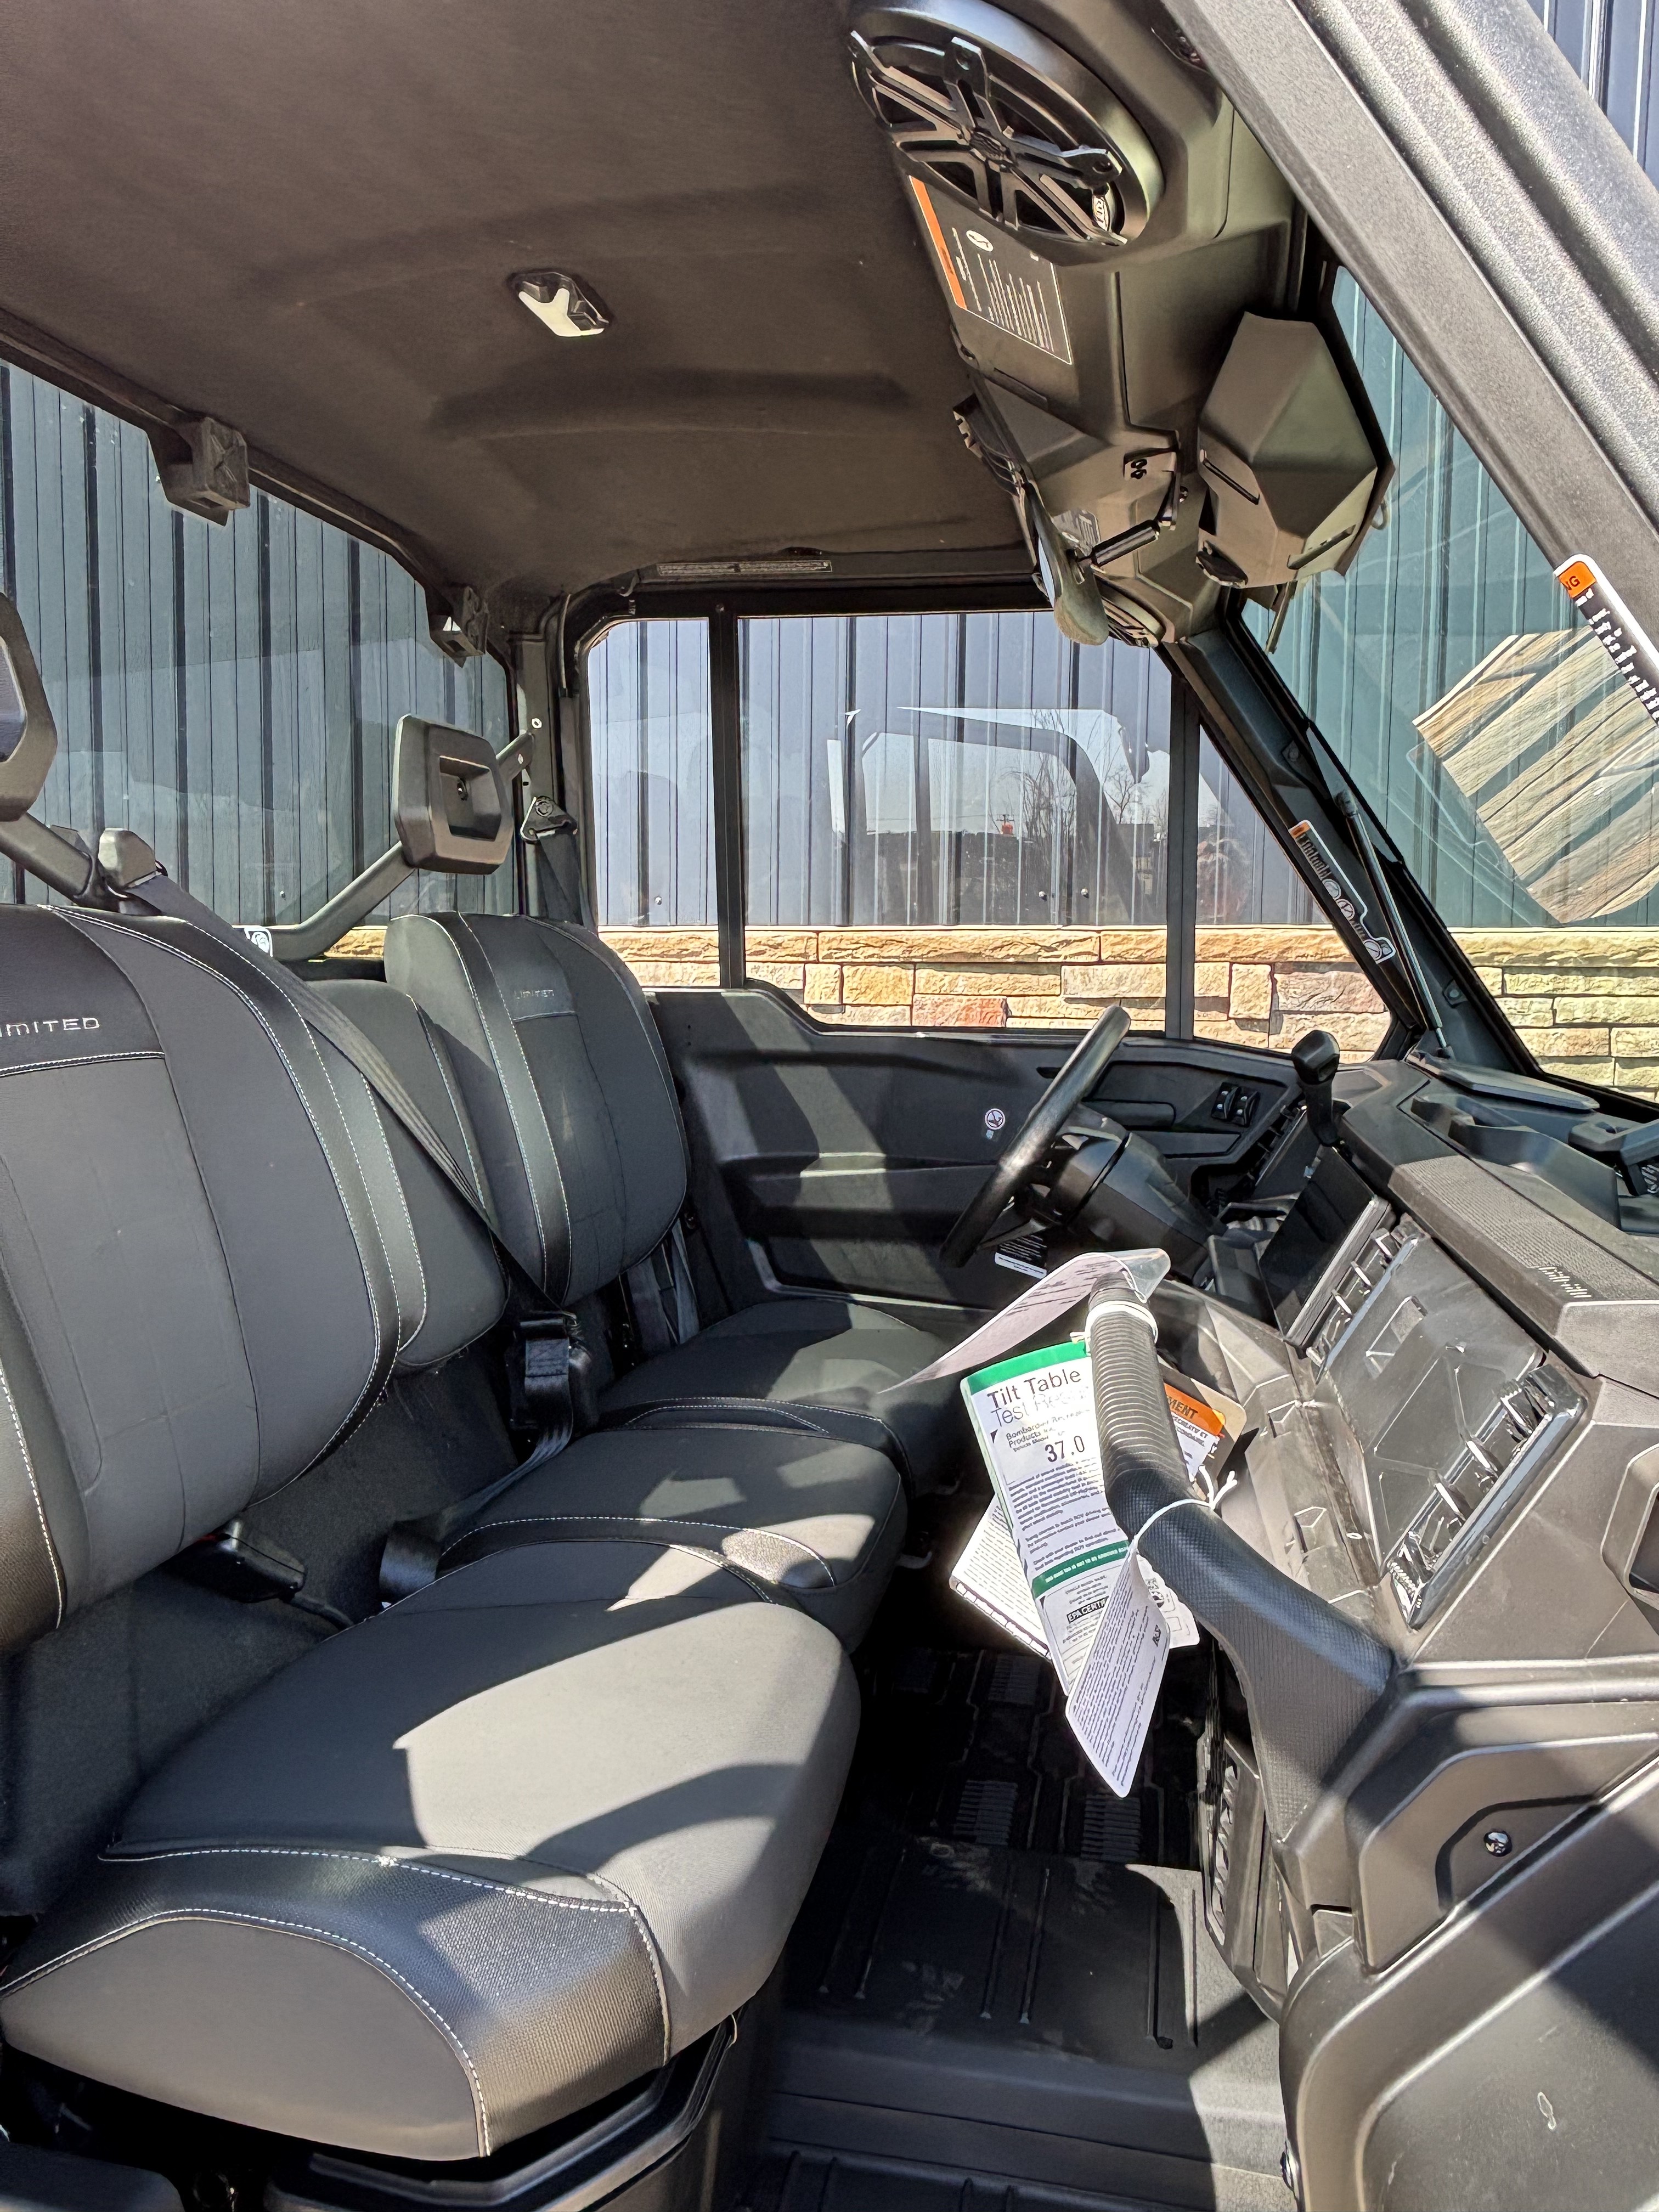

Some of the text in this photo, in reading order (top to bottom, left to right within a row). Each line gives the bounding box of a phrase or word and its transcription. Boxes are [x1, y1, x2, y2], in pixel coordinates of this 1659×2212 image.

[987, 1385, 1021, 1409] Tilt
[1024, 1369, 1081, 1395] Table
[990, 1402, 1030, 1427] Test
[1008, 1431, 1041, 1448] Products
[1045, 1436, 1085, 1463] 37.0
